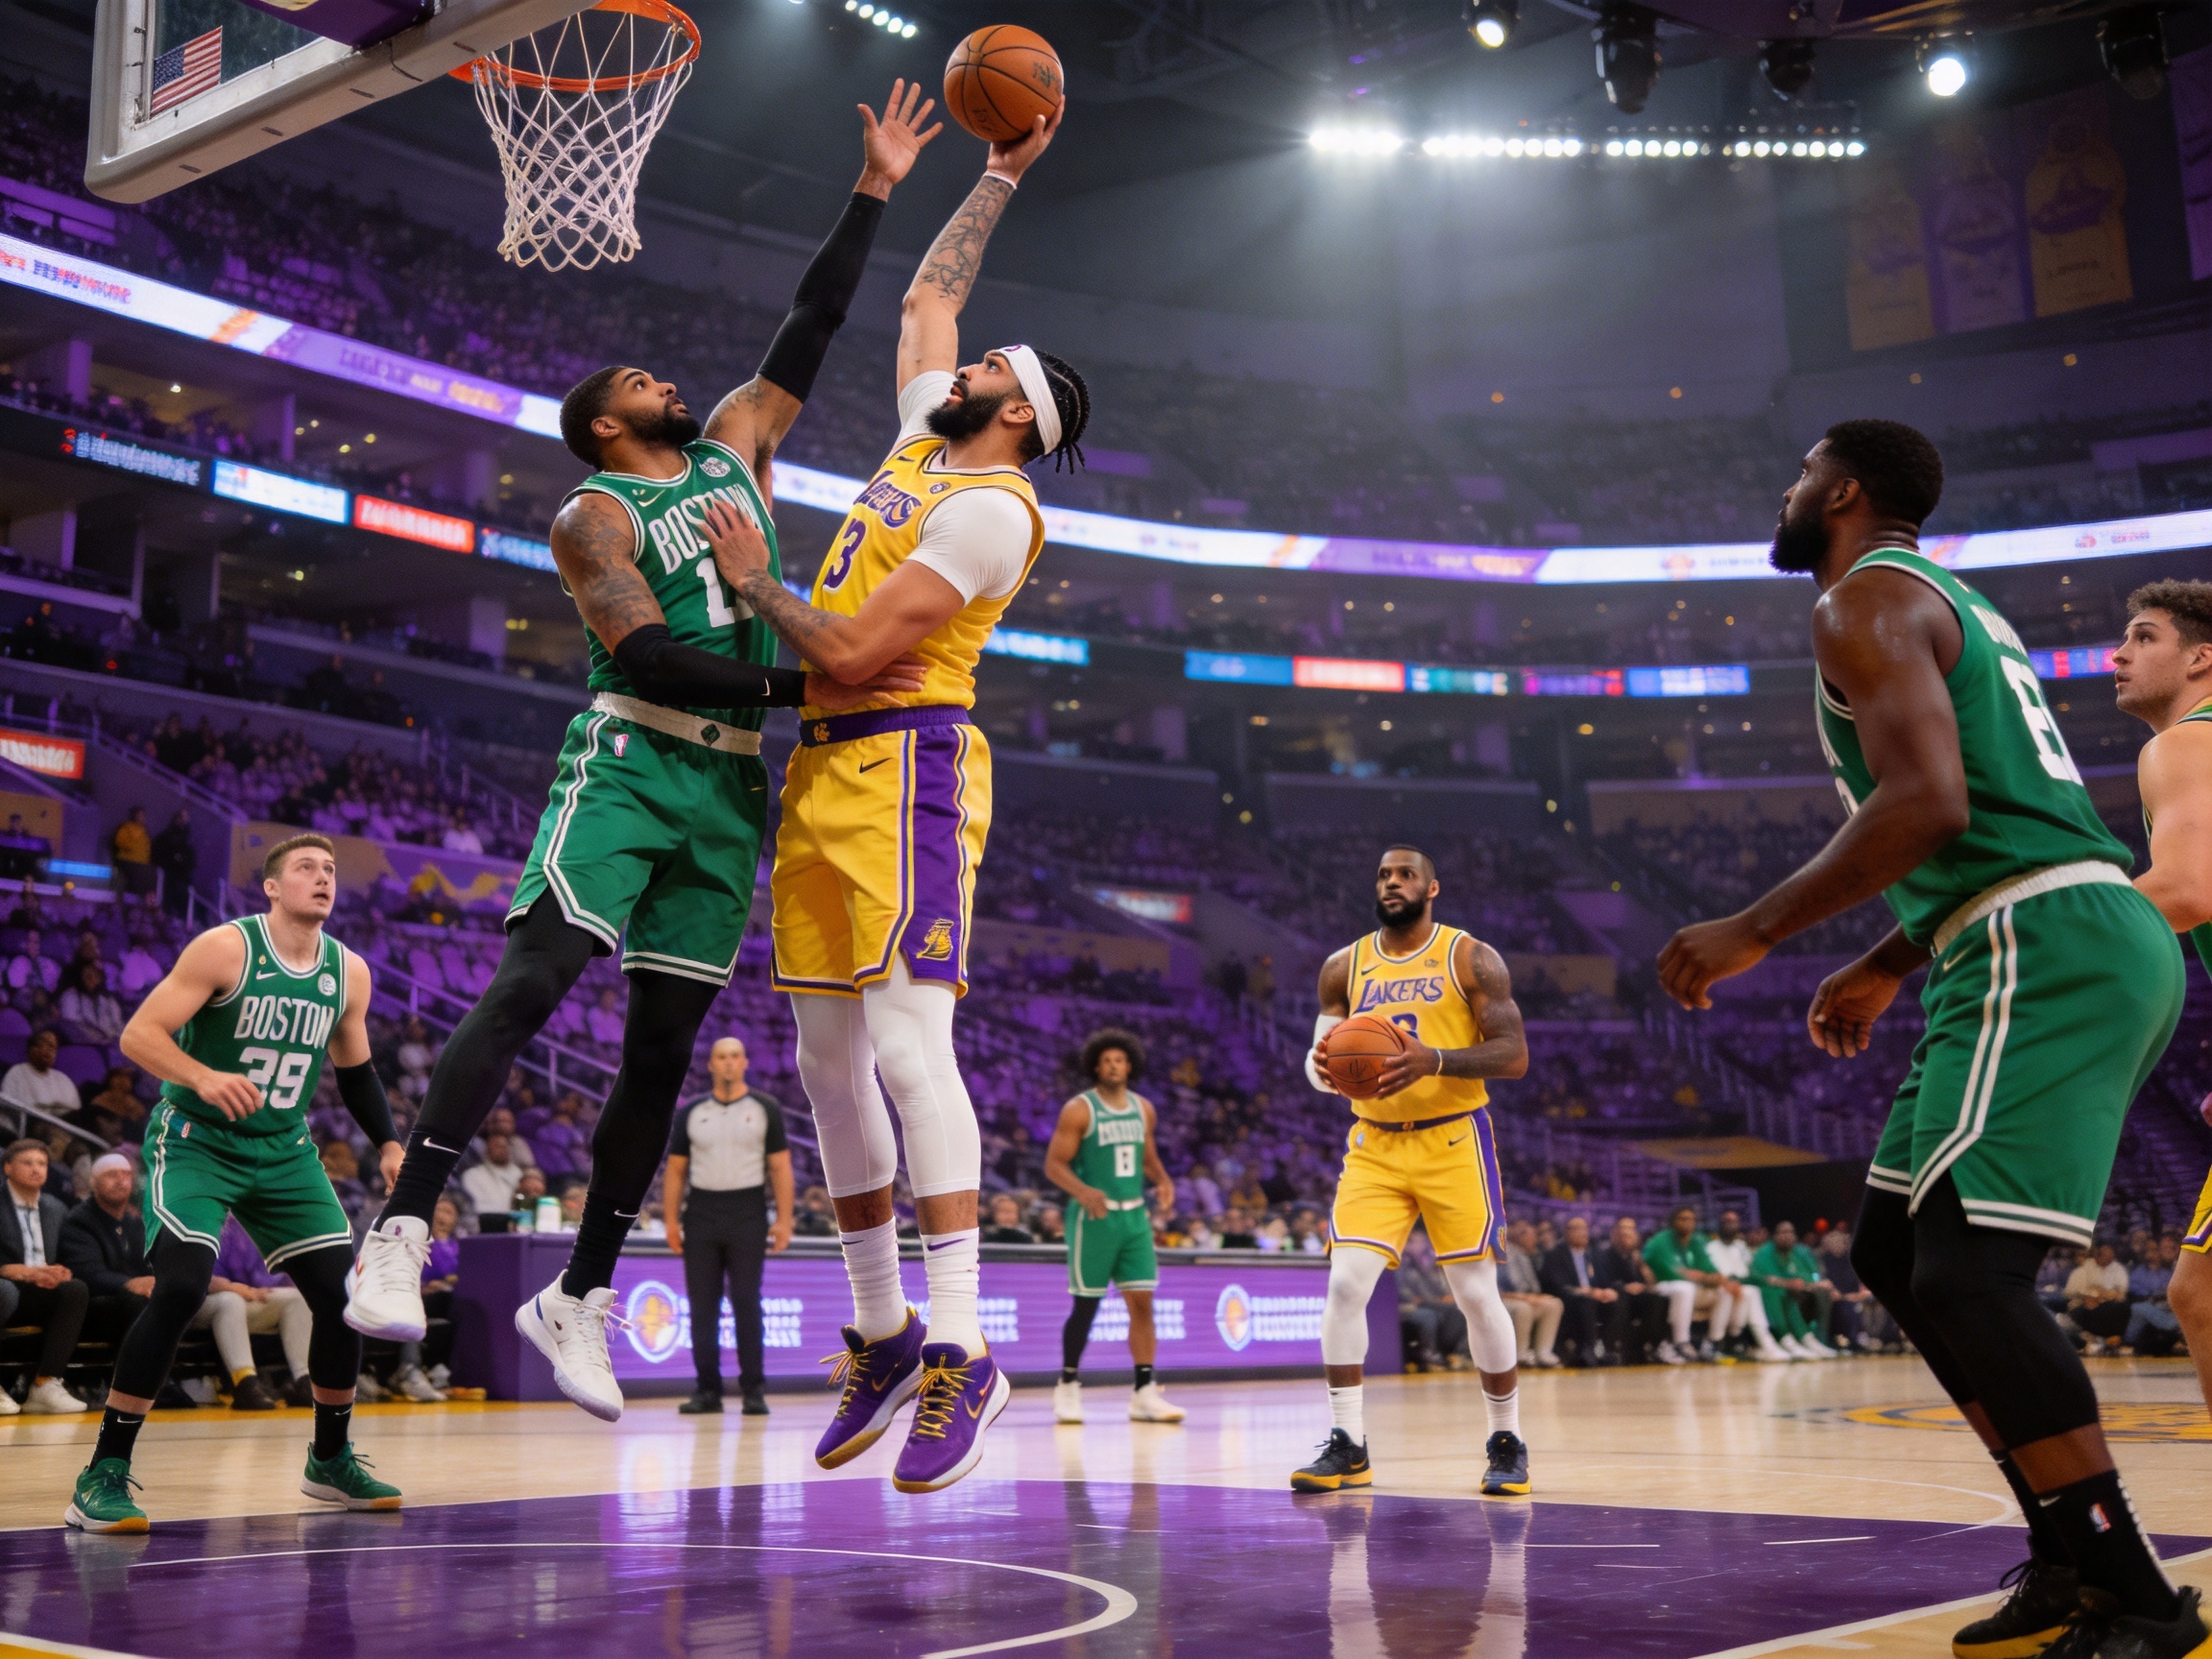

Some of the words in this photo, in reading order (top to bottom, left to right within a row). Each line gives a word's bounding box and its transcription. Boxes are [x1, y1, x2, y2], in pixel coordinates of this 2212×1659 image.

[823, 517, 867, 592] 3
[234, 995, 335, 1049] BOSTON
[1354, 976, 1444, 1014] LAKERS
